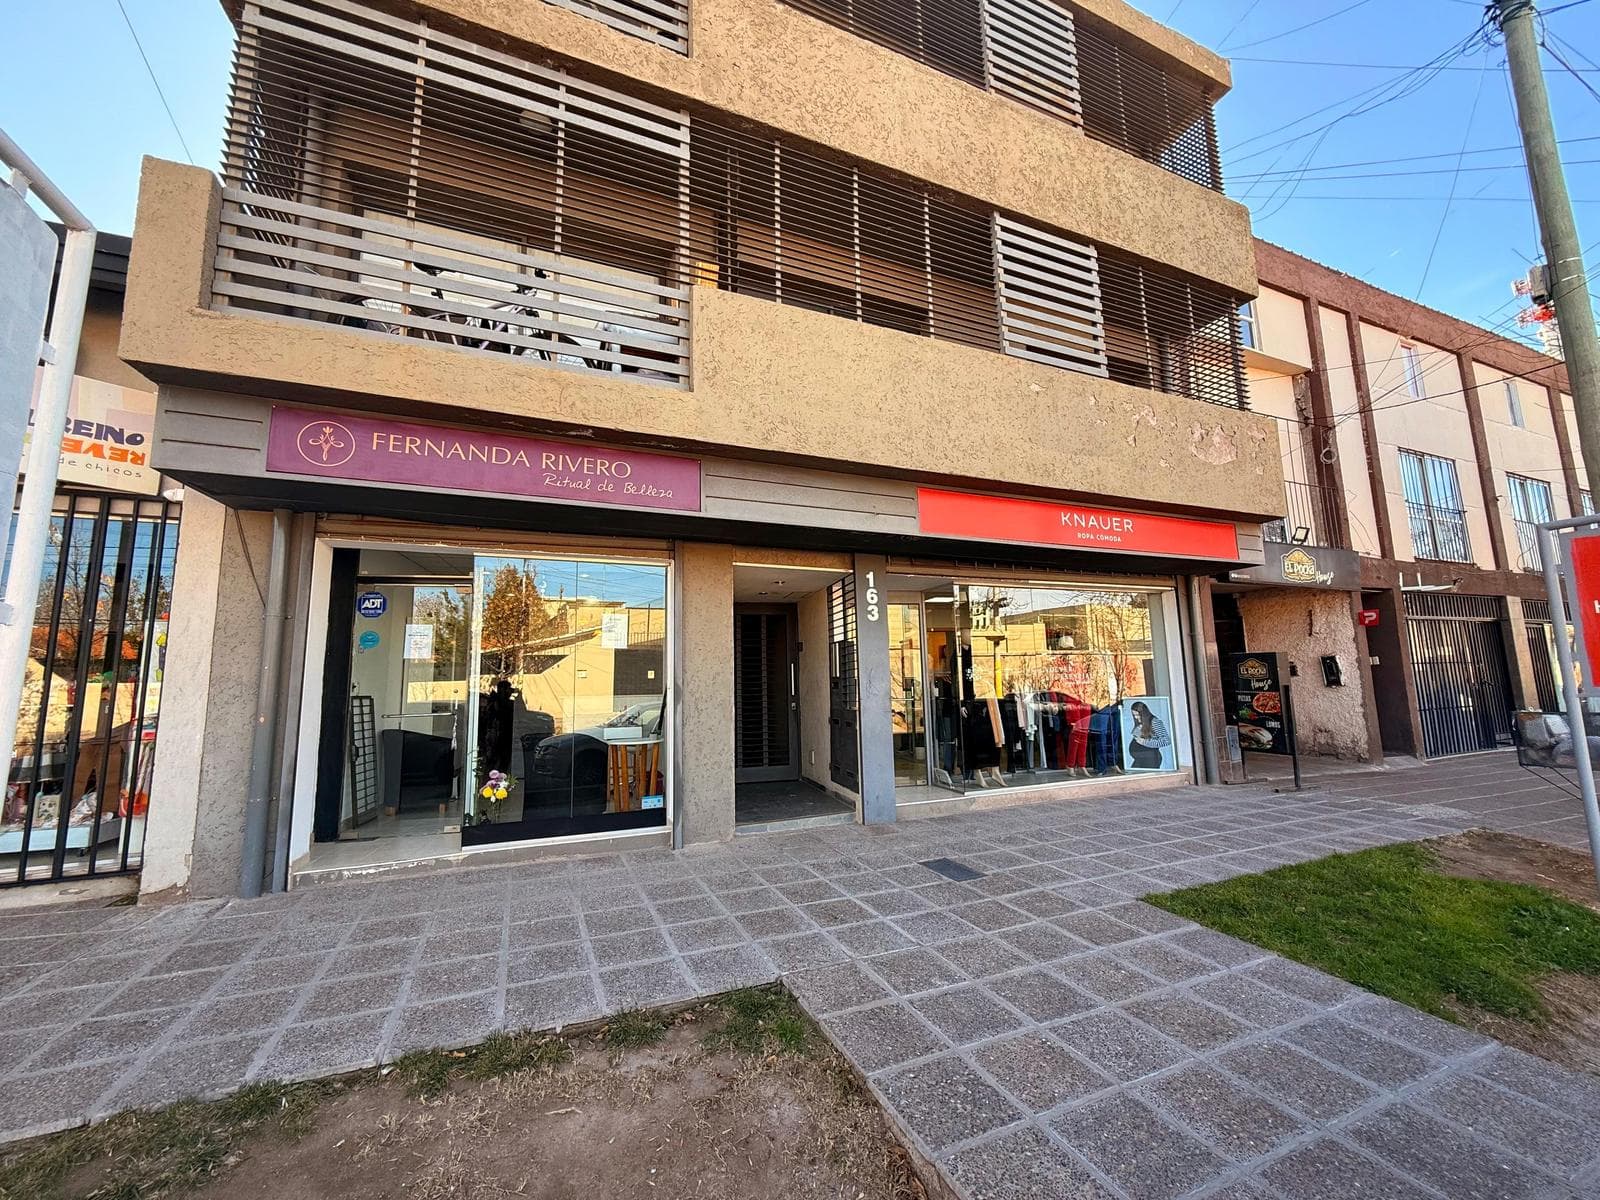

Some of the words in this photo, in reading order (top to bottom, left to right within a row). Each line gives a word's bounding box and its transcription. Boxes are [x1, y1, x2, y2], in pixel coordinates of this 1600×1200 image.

[61, 437, 146, 466] REVE
[372, 432, 532, 468] FERNANDA
[541, 452, 632, 479] RIVERO
[543, 472, 592, 491] Ritual
[597, 481, 615, 493] de
[623, 482, 674, 499] Belleza
[1060, 511, 1135, 533] KNAUER
[1077, 532, 1094, 540] ROPA
[361, 599, 383, 609] ADT
[866, 571, 879, 621] 163
